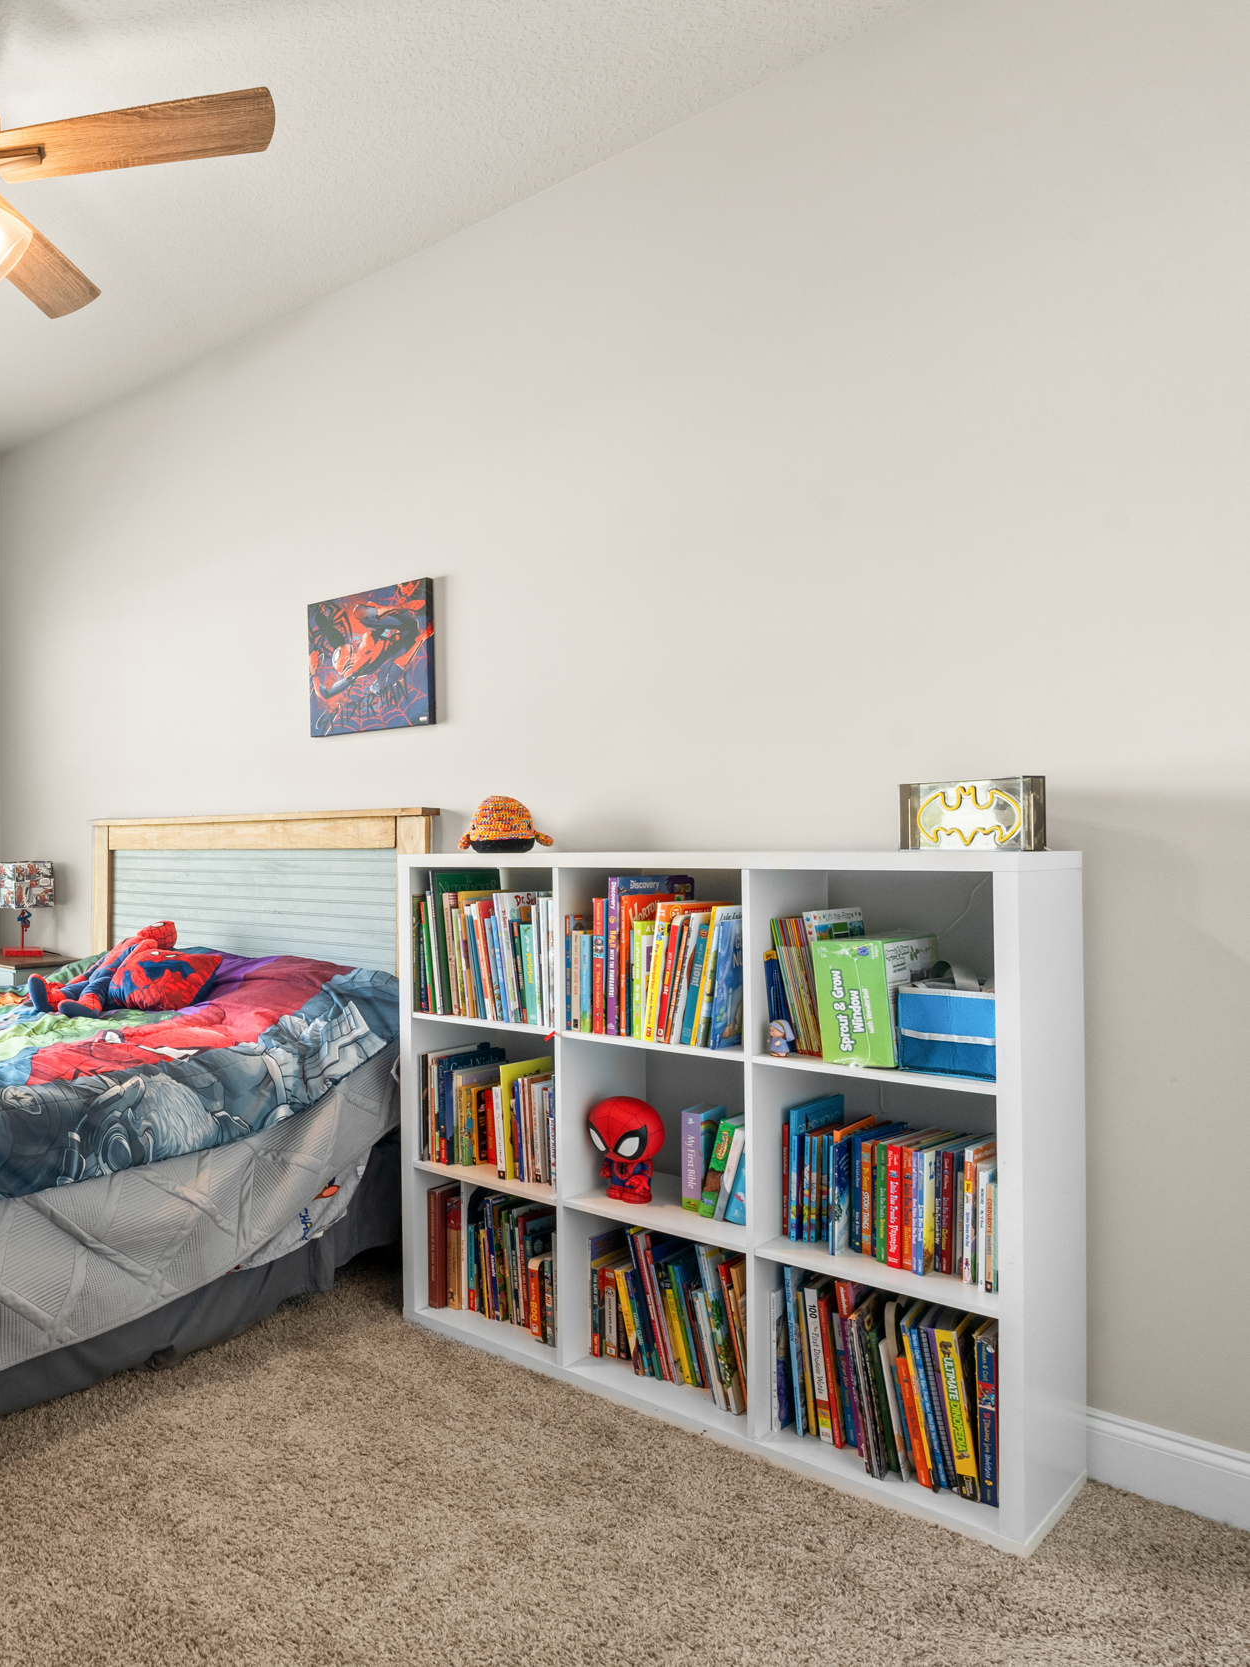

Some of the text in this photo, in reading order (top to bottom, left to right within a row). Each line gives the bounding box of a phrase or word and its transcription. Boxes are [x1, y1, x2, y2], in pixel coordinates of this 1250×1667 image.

[438, 880, 497, 894] NUTCRACKER
[609, 881, 617, 910] Discovery
[630, 880, 660, 890] Discovery
[514, 895, 527, 906] Dr.
[826, 912, 852, 921] Lift-the-Flap
[650, 943, 659, 990] Pre-Kindergarten
[690, 963, 702, 986] lion!
[635, 984, 640, 992] On
[831, 970, 856, 1052] Sprout & Grow
[848, 989, 866, 1034] Window
[863, 988, 875, 1034] with WonderSoil
[717, 1132, 729, 1160] Beginner's
[687, 1134, 696, 1189] My First Bible
[889, 1180, 898, 1193] Little
[889, 1194, 898, 1204] Blue
[889, 1205, 898, 1223] Truck's
[904, 1183, 912, 1254] Little Blue Truck's Halloween
[530, 1300, 538, 1321] BOO
[668, 1300, 676, 1312] GREAT
[839, 1286, 848, 1315] nickelodeon
[616, 1312, 626, 1349] Spooky Pookie
[632, 1312, 644, 1346] Gobble, Gobble
[787, 1321, 795, 1342] FROZEN
[807, 1303, 826, 1394] 100 First Dinosaur Words
[910, 1333, 921, 1359] Martin Carle
[981, 1342, 989, 1363] reedman
[917, 1367, 925, 1378] Polar
[919, 1378, 928, 1389] Bear,
[922, 1390, 930, 1401] Polar
[924, 1400, 932, 1412] Bear,
[941, 1356, 968, 1451] ULTIMATE DINOPEDIA
[926, 1413, 935, 1424] What
[930, 1430, 938, 1439] You
[913, 1439, 924, 1462] Halloween
[932, 1440, 940, 1452] Hear?
[983, 1442, 992, 1453] Love
